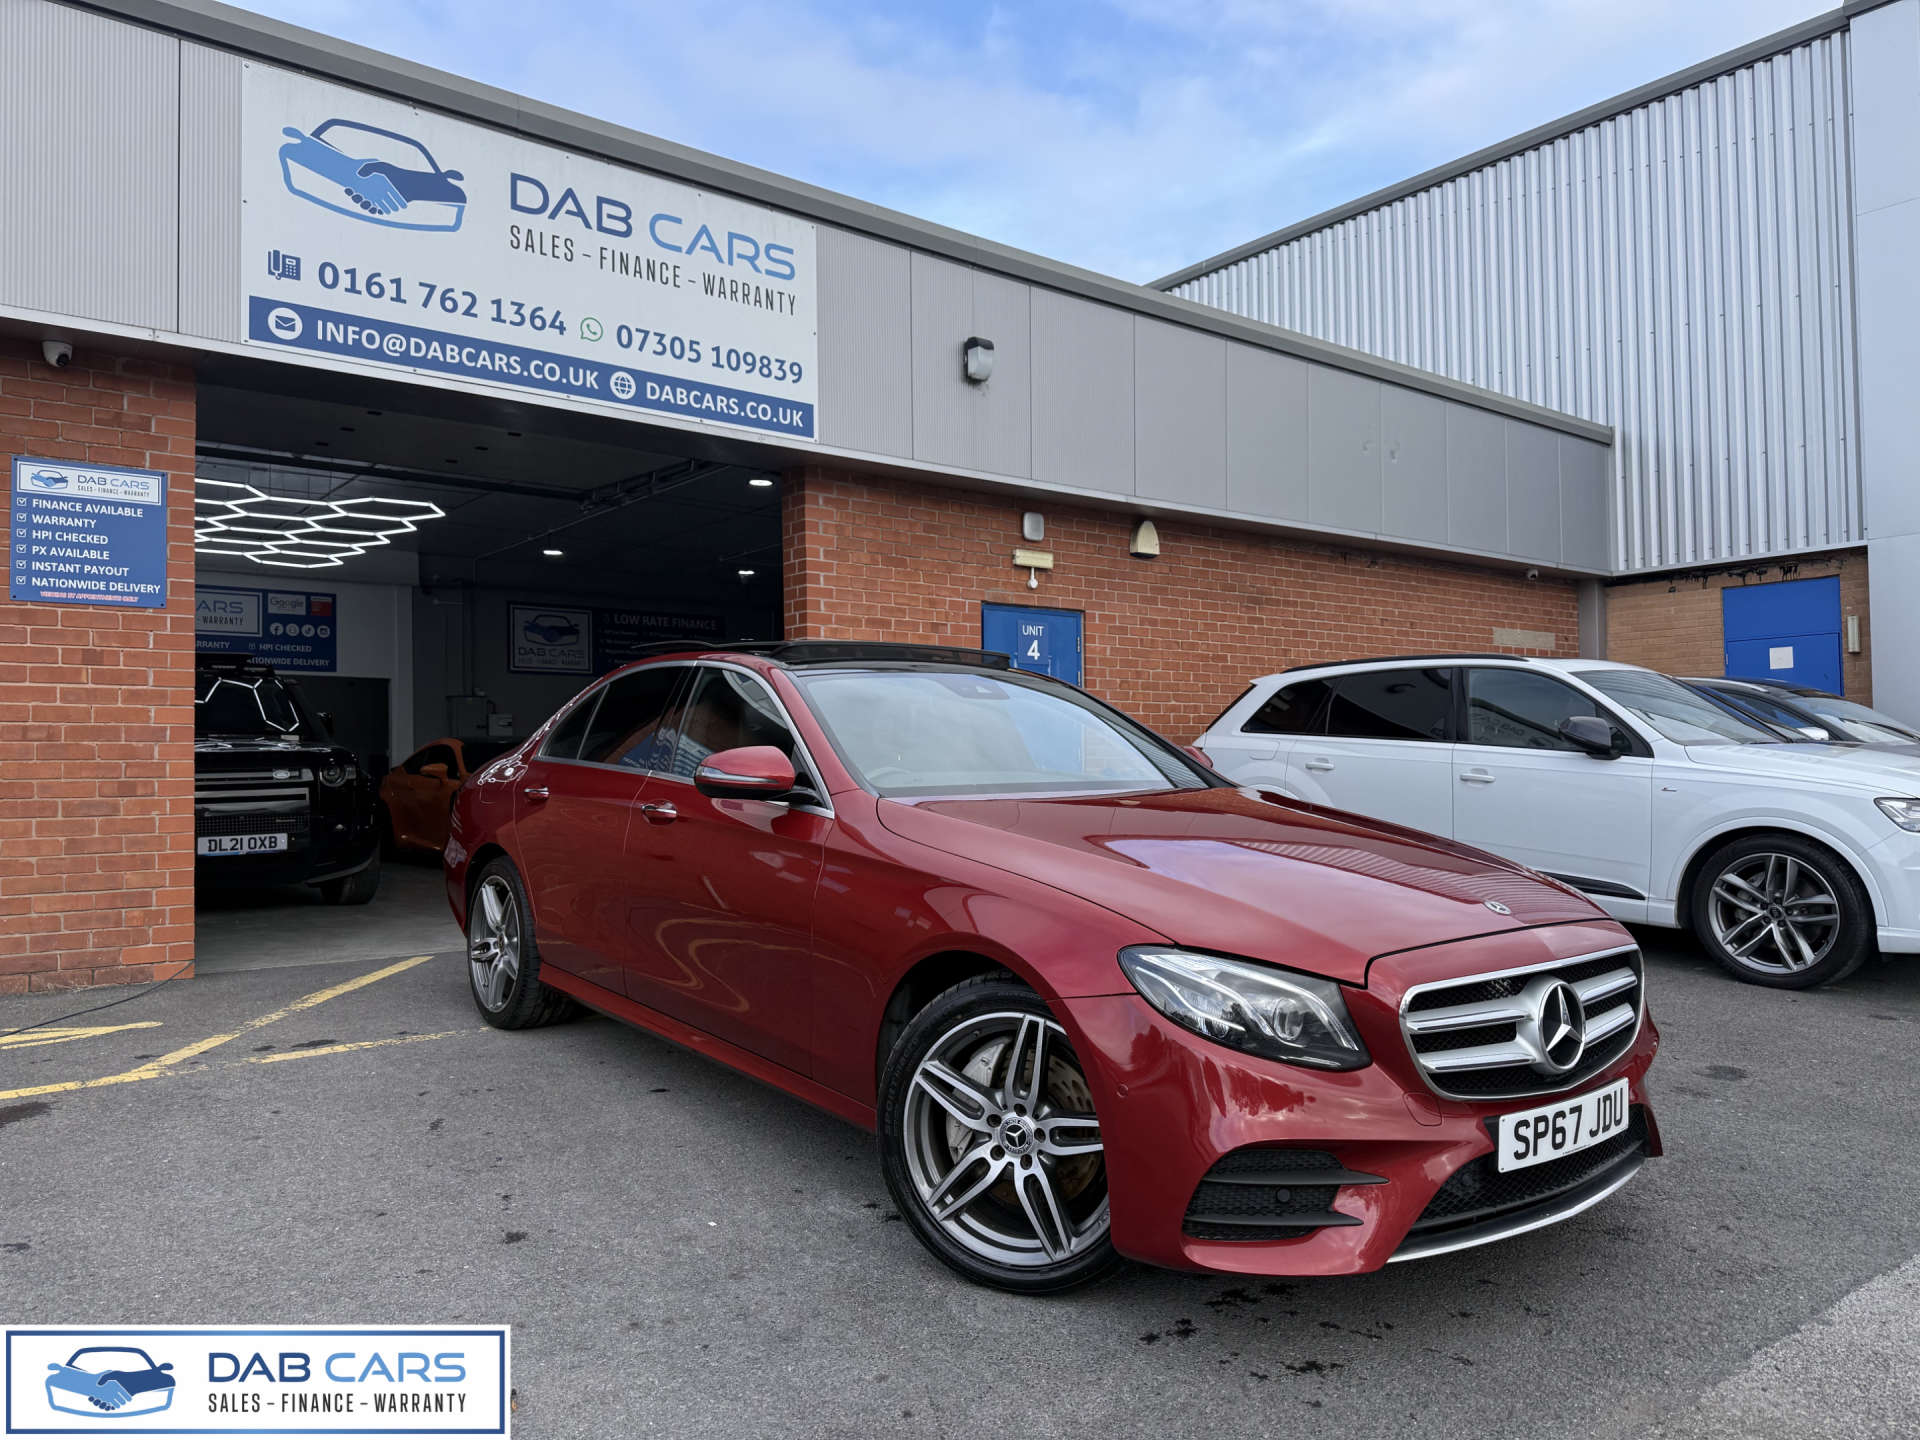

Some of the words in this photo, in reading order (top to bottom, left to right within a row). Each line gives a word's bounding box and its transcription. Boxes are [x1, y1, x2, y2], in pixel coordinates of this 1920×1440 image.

[510, 172, 633, 238] DAB
[649, 213, 796, 281] CARS
[510, 224, 574, 262] SALES
[600, 246, 681, 288] FINANCE
[703, 271, 796, 316] WARRANTY
[318, 261, 407, 304] 0161
[418, 282, 478, 318] 762
[490, 298, 566, 336] 1364
[317, 319, 599, 390] INFO@DABCARS.CO.UK
[617, 324, 702, 363] 07305
[711, 345, 803, 384] 109839
[646, 381, 804, 428] DABCARS.CO.UK
[77, 474, 107, 486] DAB
[110, 478, 150, 490] CARS
[32, 498, 82, 512] FINANCE
[85, 503, 144, 518] AVAILABLE
[32, 514, 97, 529] WARRANTY
[32, 529, 53, 541] HPI
[55, 531, 109, 545] CHECKED
[32, 545, 47, 556] PX
[50, 547, 110, 560] AVAILABLE
[32, 561, 81, 574] INSTANT
[84, 564, 130, 577] PAYOUT
[32, 577, 107, 590] NATIONWIDE
[109, 581, 161, 594] DELIVERY
[196, 599, 244, 614] ARS
[1022, 624, 1045, 637] UNIT
[1027, 639, 1041, 661] 4
[207, 837, 243, 852] DL21
[247, 835, 278, 850] OXB
[1513, 1104, 1583, 1160] SP67
[1589, 1088, 1623, 1138] JDU
